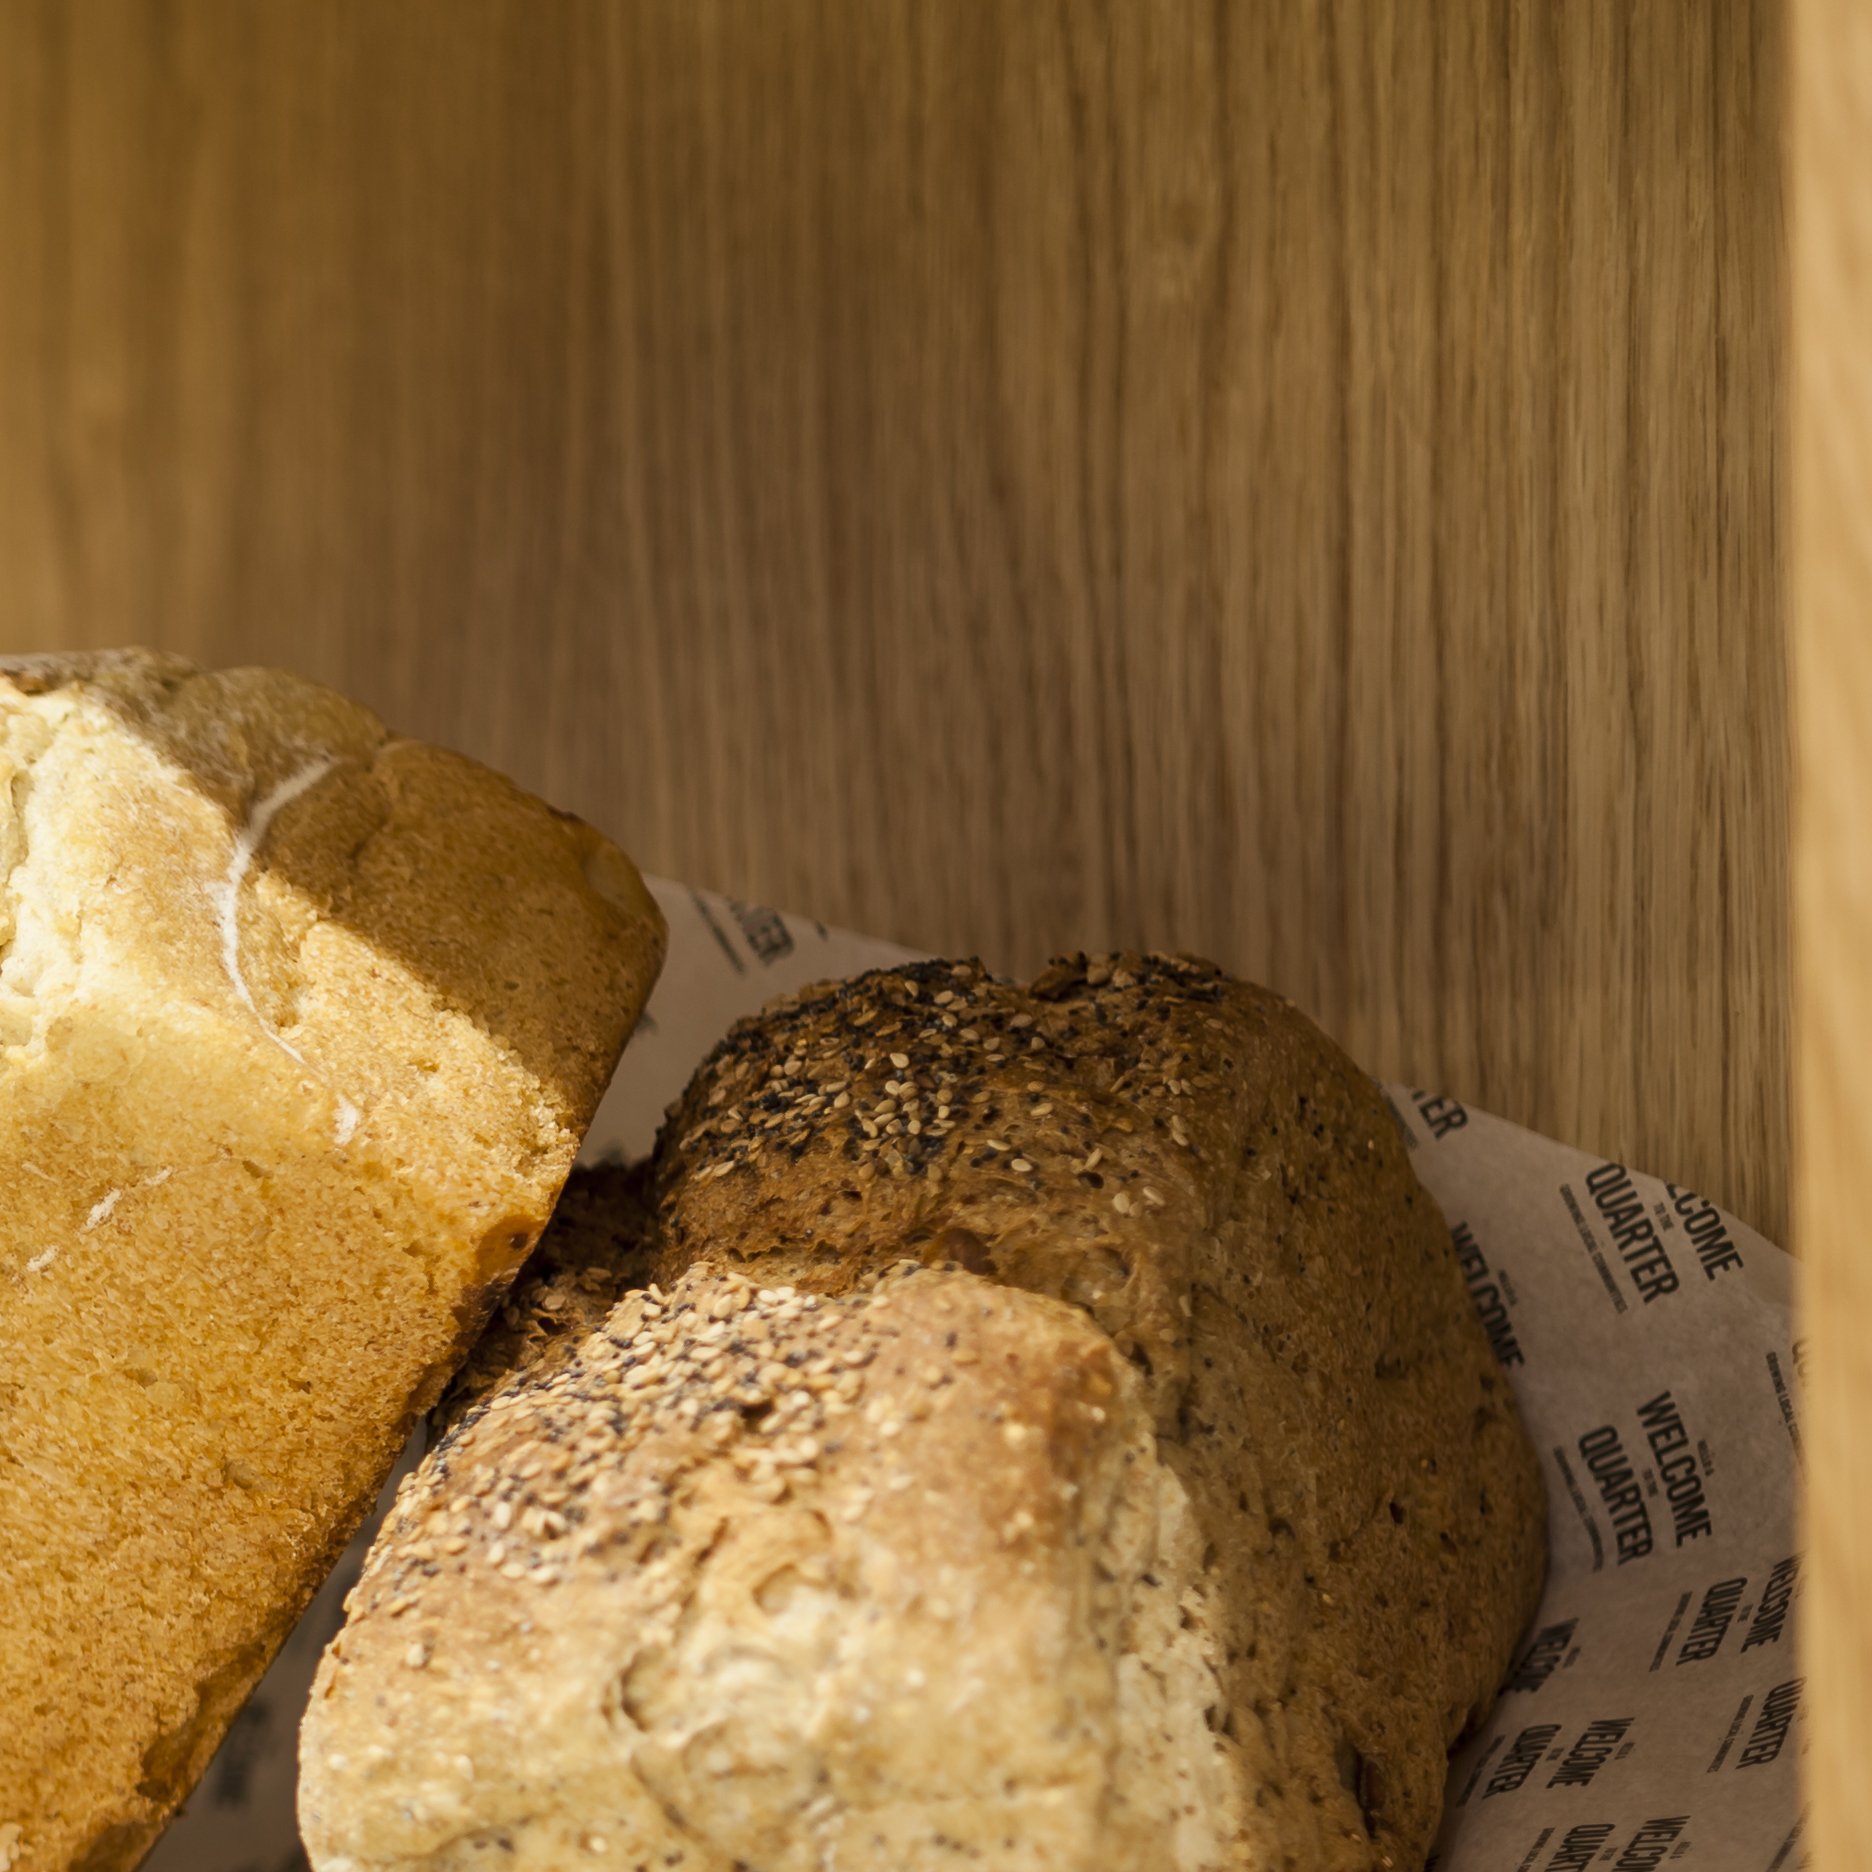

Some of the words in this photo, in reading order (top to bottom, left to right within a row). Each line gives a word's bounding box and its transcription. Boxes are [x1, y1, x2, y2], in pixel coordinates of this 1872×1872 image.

[1586, 1163, 1679, 1305] QUARTER
[1579, 1424, 1653, 1566] QUARTER
[1637, 1390, 1712, 1548] WELCOME
[1676, 1577, 1748, 1666] QUARTER
[1546, 1717, 1635, 1789] WELCOME
